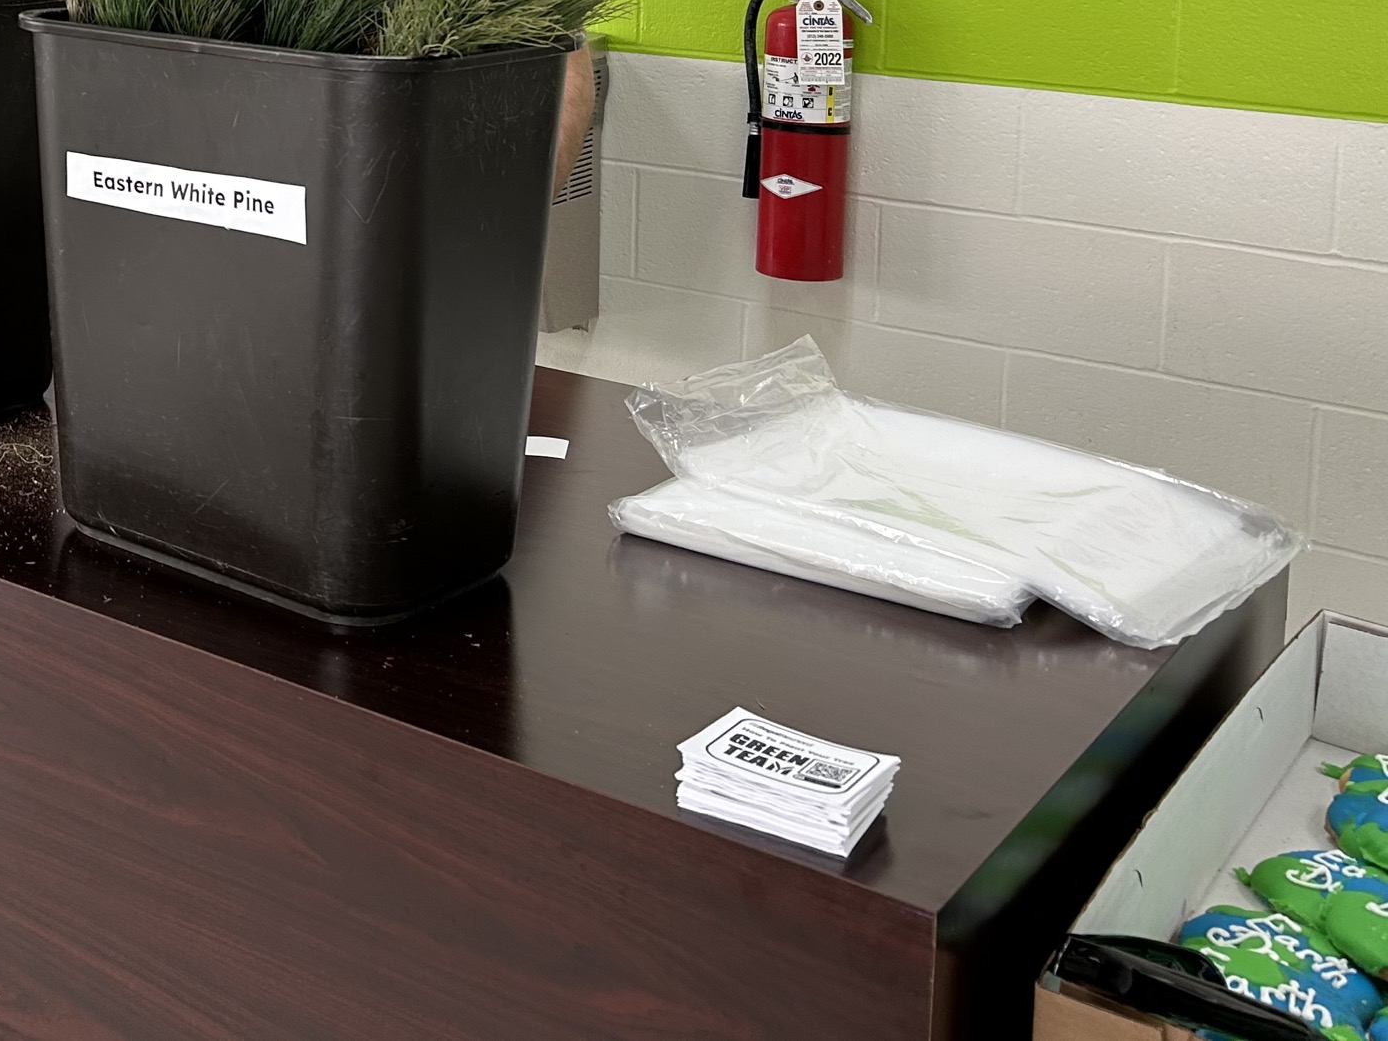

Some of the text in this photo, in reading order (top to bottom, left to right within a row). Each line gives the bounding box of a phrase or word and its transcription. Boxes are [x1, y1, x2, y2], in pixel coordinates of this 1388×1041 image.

[814, 52, 842, 66] 2022
[93, 171, 275, 215] Eastern White Pine
[723, 743, 796, 776] TEAM
[729, 733, 811, 767] GREEN
[742, 726, 763, 737] How
[779, 741, 806, 752] Plant
[808, 750, 831, 760] Your
[834, 758, 855, 766] Tree
